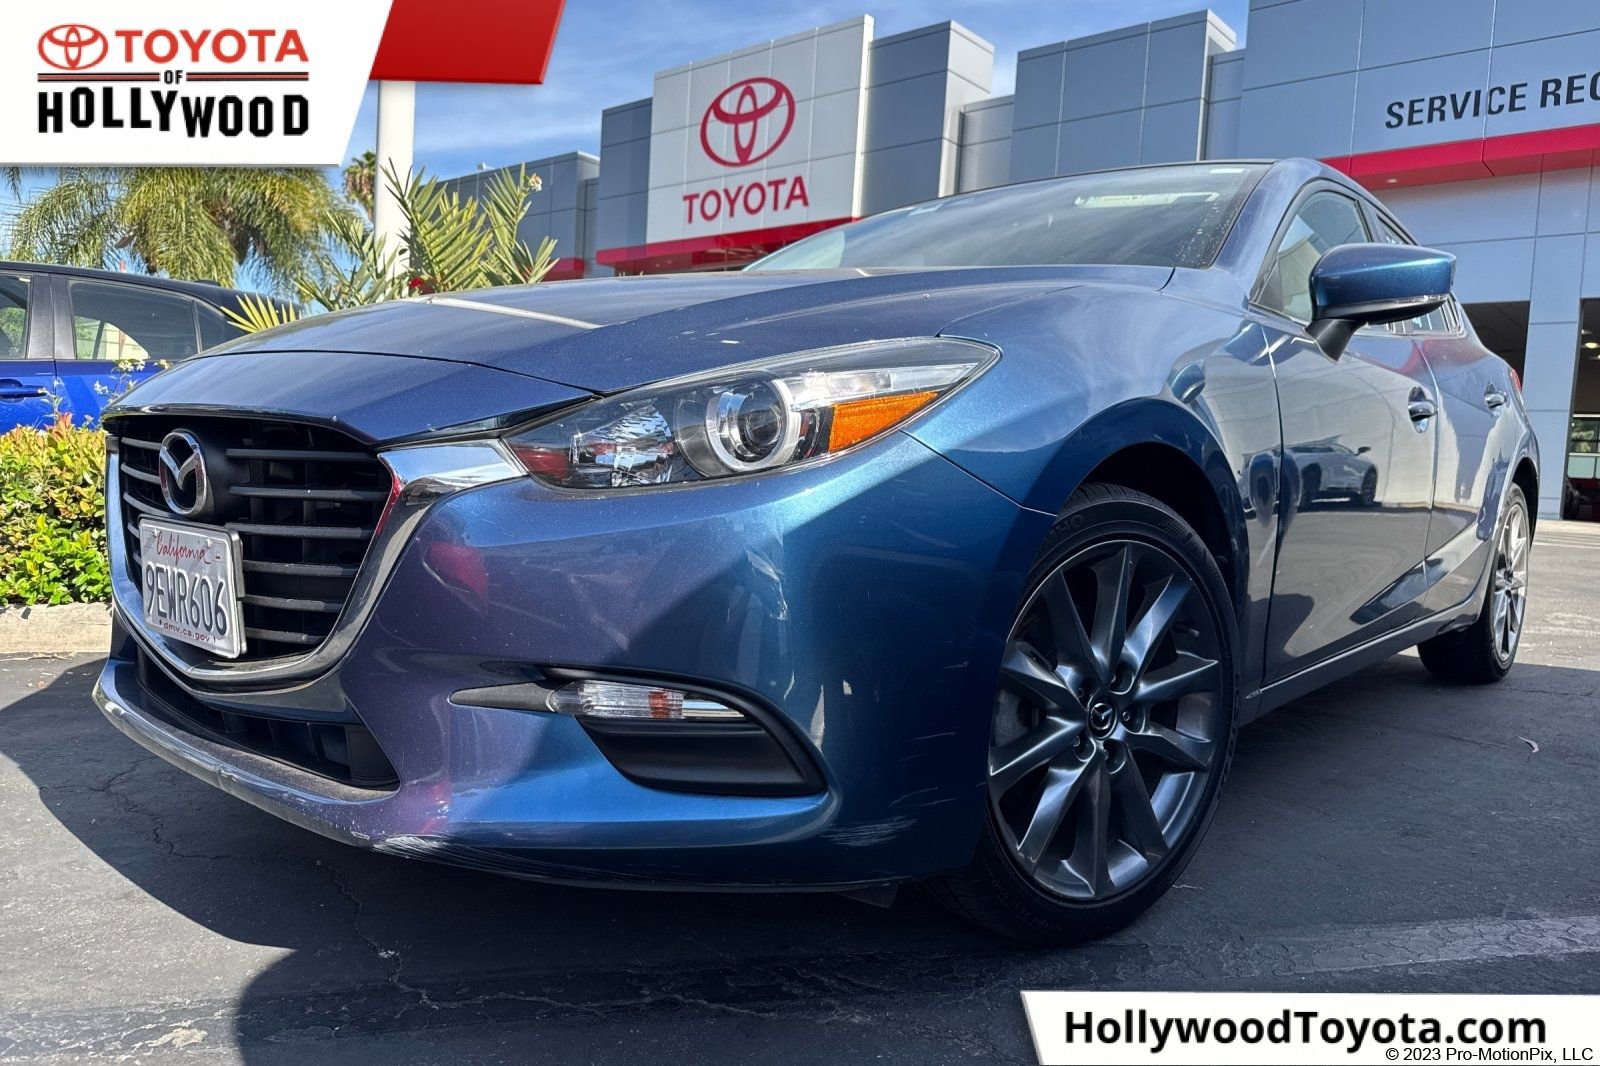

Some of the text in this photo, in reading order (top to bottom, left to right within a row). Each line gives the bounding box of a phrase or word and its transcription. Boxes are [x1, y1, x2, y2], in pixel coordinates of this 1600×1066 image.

[1385, 82, 1528, 130] SERVICE
[682, 176, 809, 224] TOYOTA
[156, 530, 211, 566] California
[145, 563, 227, 636] 9EWR606
[163, 622, 211, 642] dmv.ca.gov
